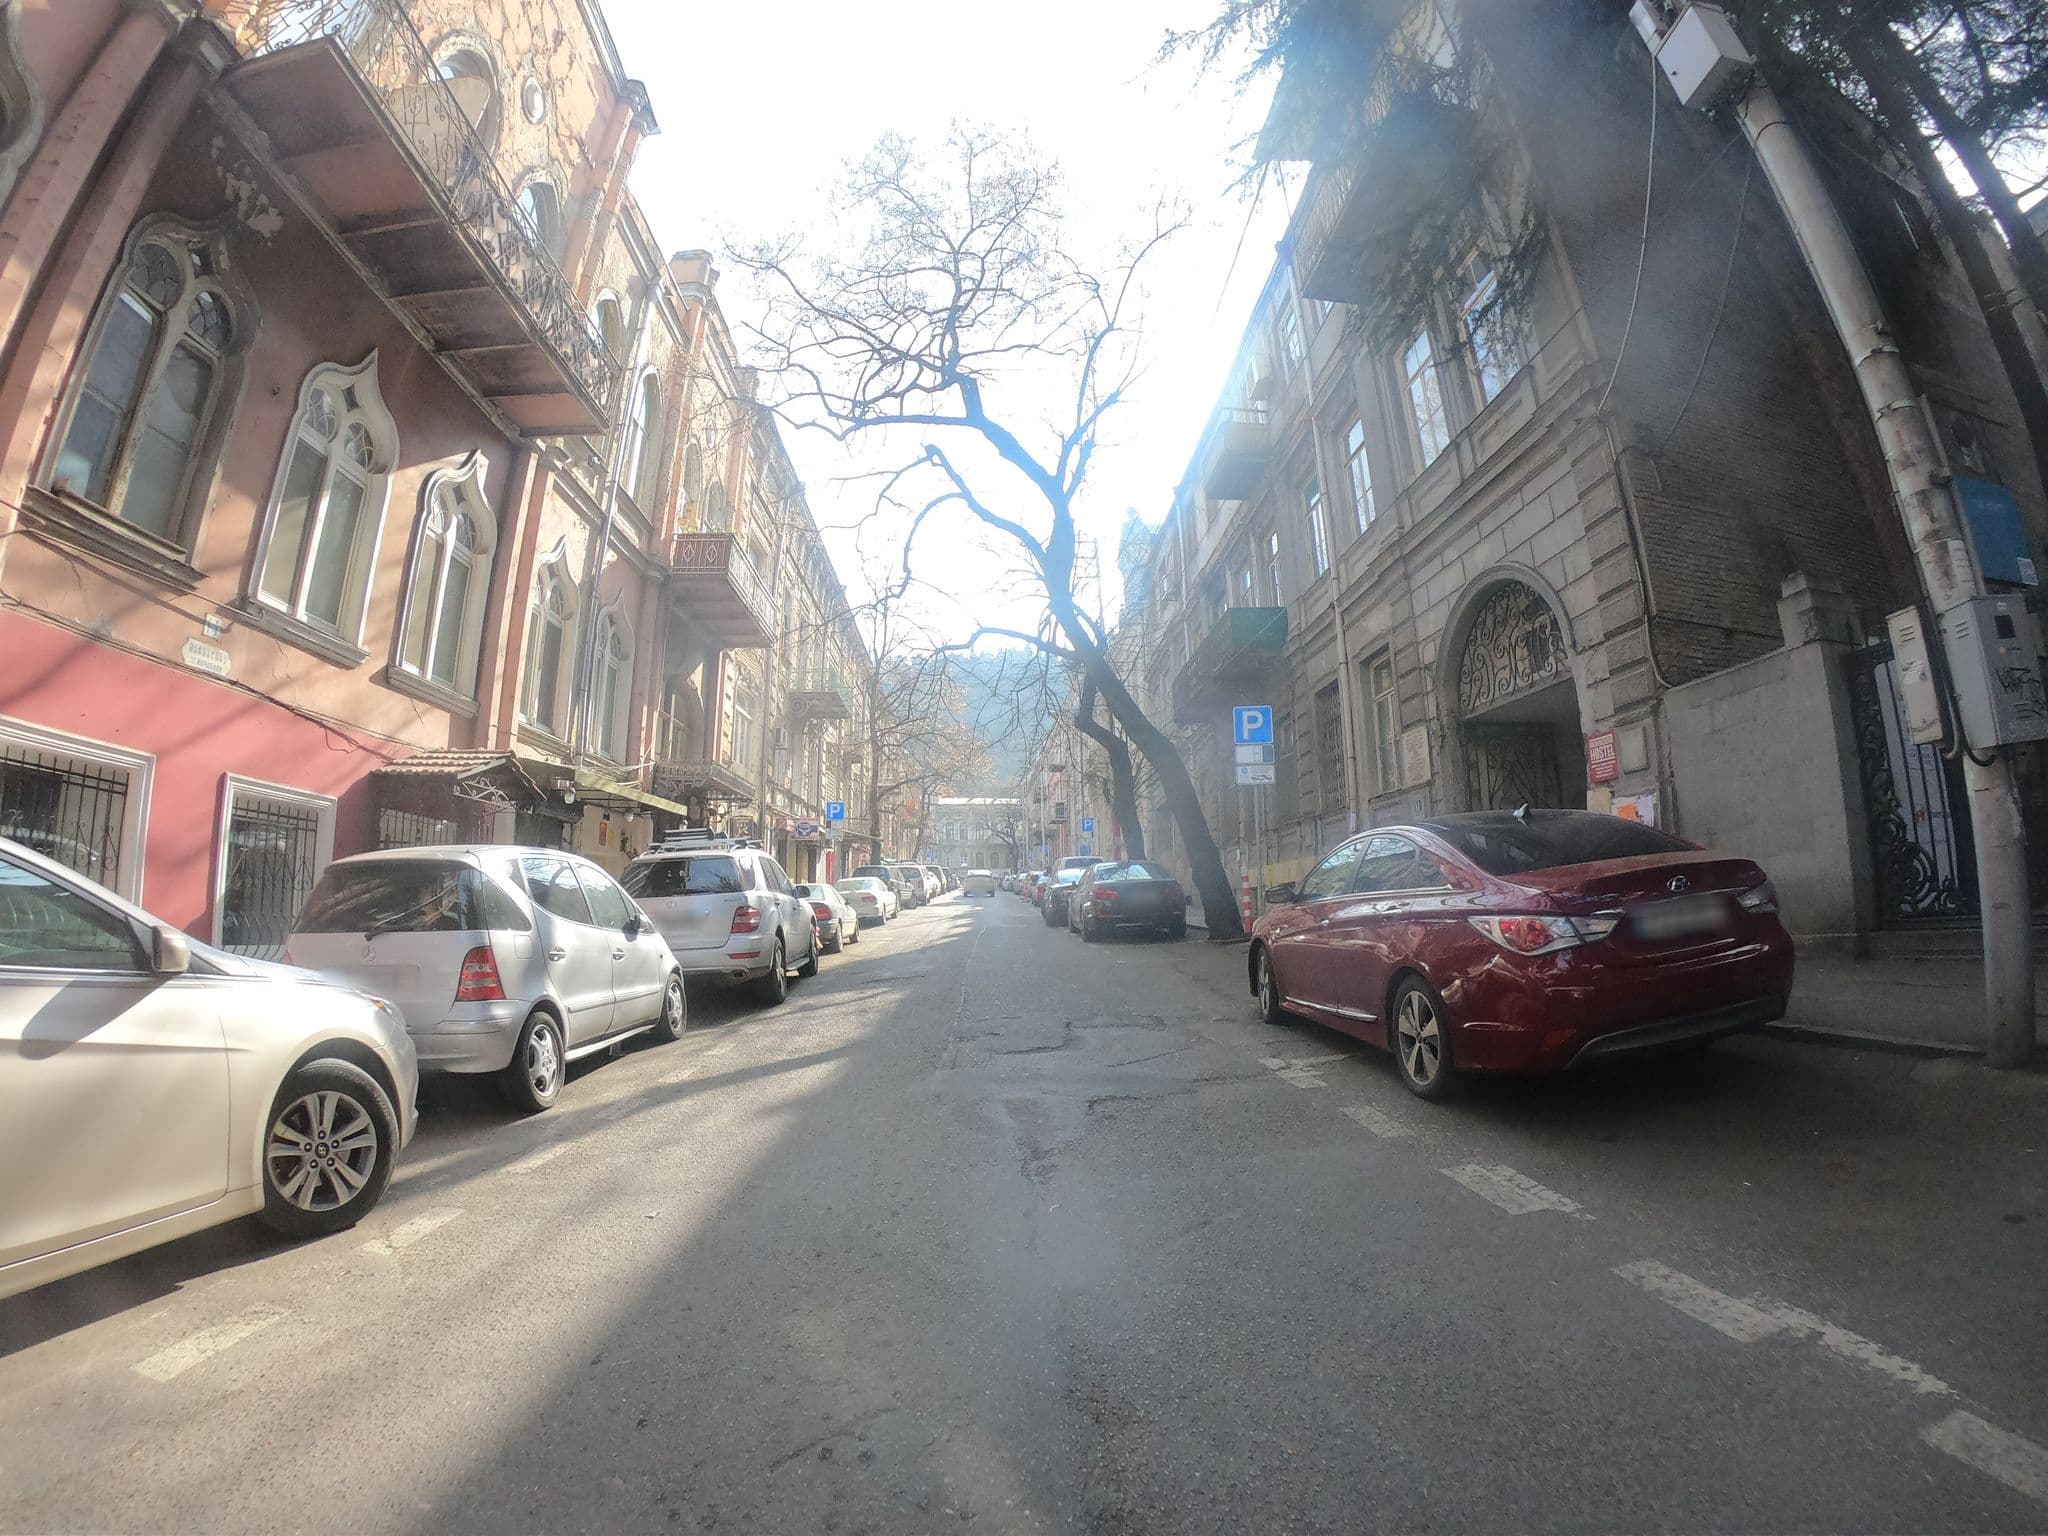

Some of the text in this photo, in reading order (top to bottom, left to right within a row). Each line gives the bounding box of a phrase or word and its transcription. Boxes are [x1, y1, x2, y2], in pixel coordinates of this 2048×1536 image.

[1242, 710, 1264, 740] P
[1590, 744, 1616, 761] HOSTEL
[830, 804, 841, 818] P
[1084, 819, 1092, 831] P
